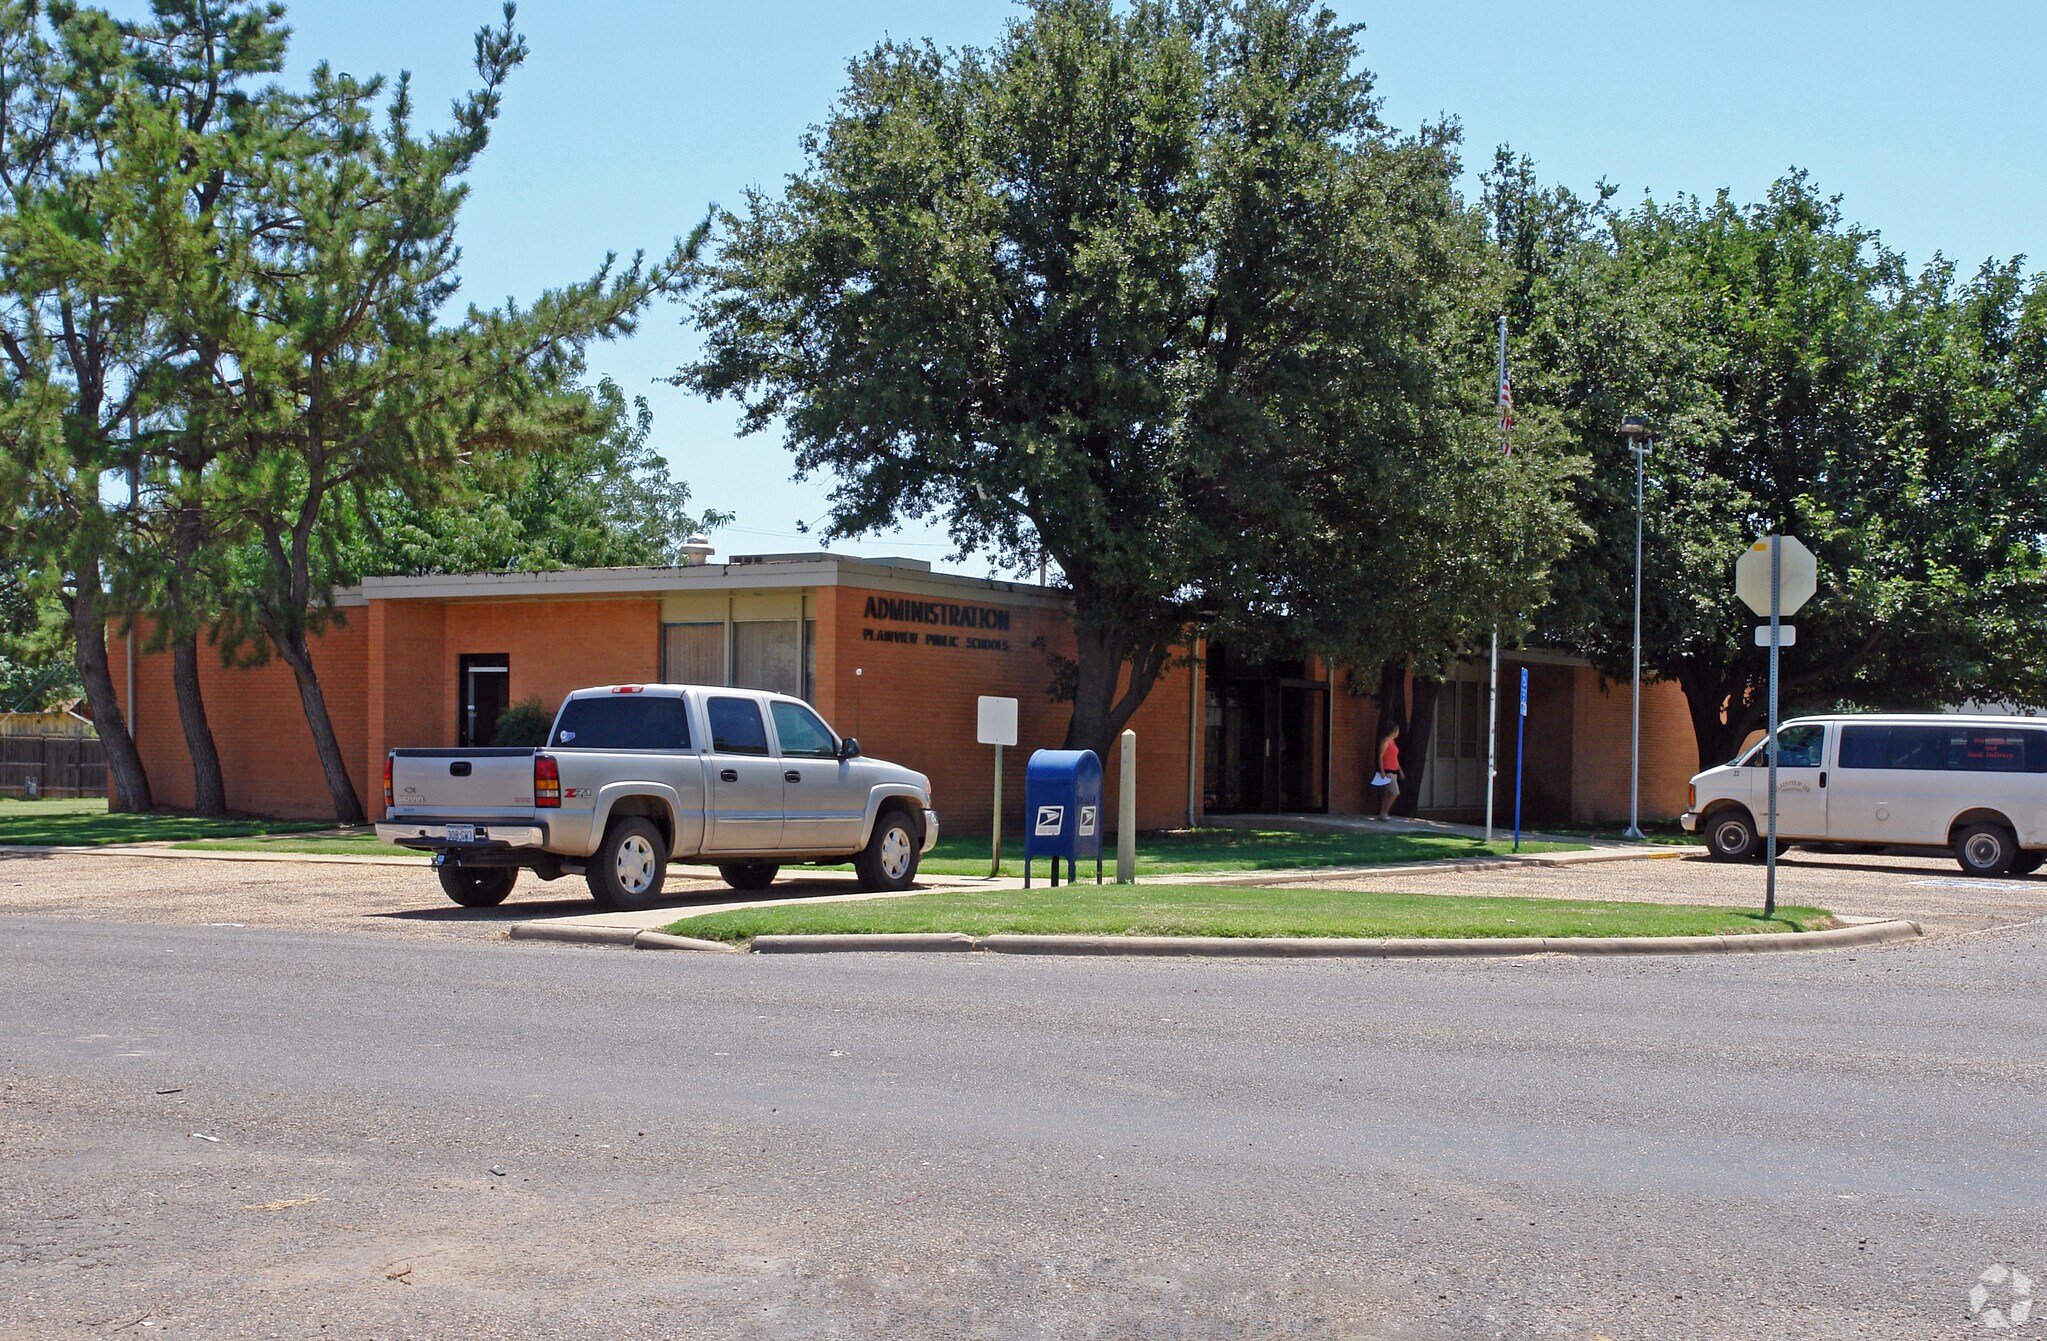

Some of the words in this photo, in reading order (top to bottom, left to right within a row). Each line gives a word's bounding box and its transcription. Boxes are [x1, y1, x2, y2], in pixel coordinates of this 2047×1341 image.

[863, 596, 1010, 631] ADMINISTRATION
[863, 628, 918, 644] PLAINVIEW
[925, 632, 958, 648] PUBLIC
[966, 637, 1009, 651] SCHOOLS
